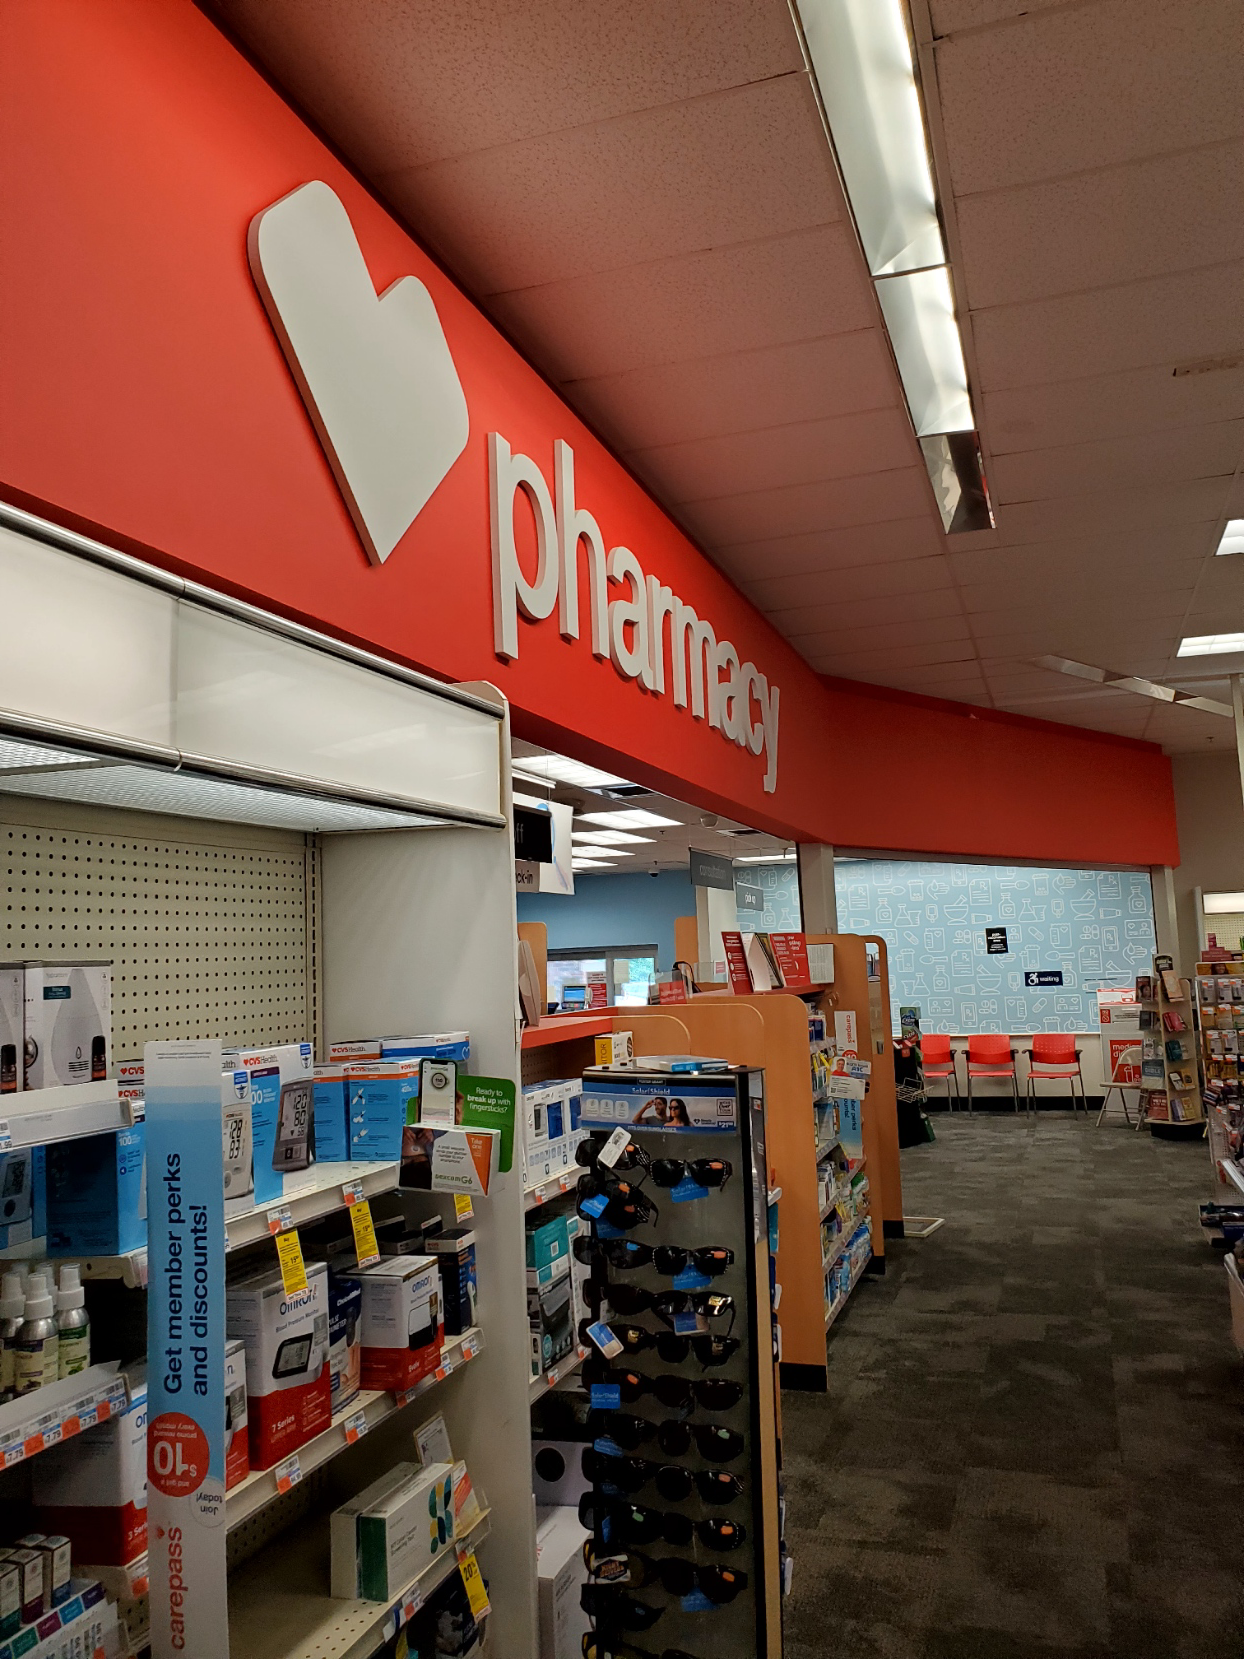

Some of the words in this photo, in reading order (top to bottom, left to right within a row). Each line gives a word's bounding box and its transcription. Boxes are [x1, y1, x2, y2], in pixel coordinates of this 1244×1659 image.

[488, 431, 780, 794] pharmacy
[1039, 975, 1060, 983] waiting
[467, 1094, 487, 1104] break
[487, 1097, 497, 1106] up
[497, 1098, 511, 1106] with
[469, 1102, 508, 1113] fingersticks?
[475, 1086, 495, 1097] Ready
[496, 1089, 503, 1097] to
[163, 1153, 186, 1224] perks
[164, 1230, 183, 1340] member
[189, 1205, 208, 1339] discounts!
[163, 1347, 183, 1394] Get
[190, 1346, 209, 1397] and
[153, 1440, 198, 1478] $10
[196, 1492, 223, 1504] today!
[200, 1505, 219, 1516] Join
[168, 1526, 189, 1651] carepass
